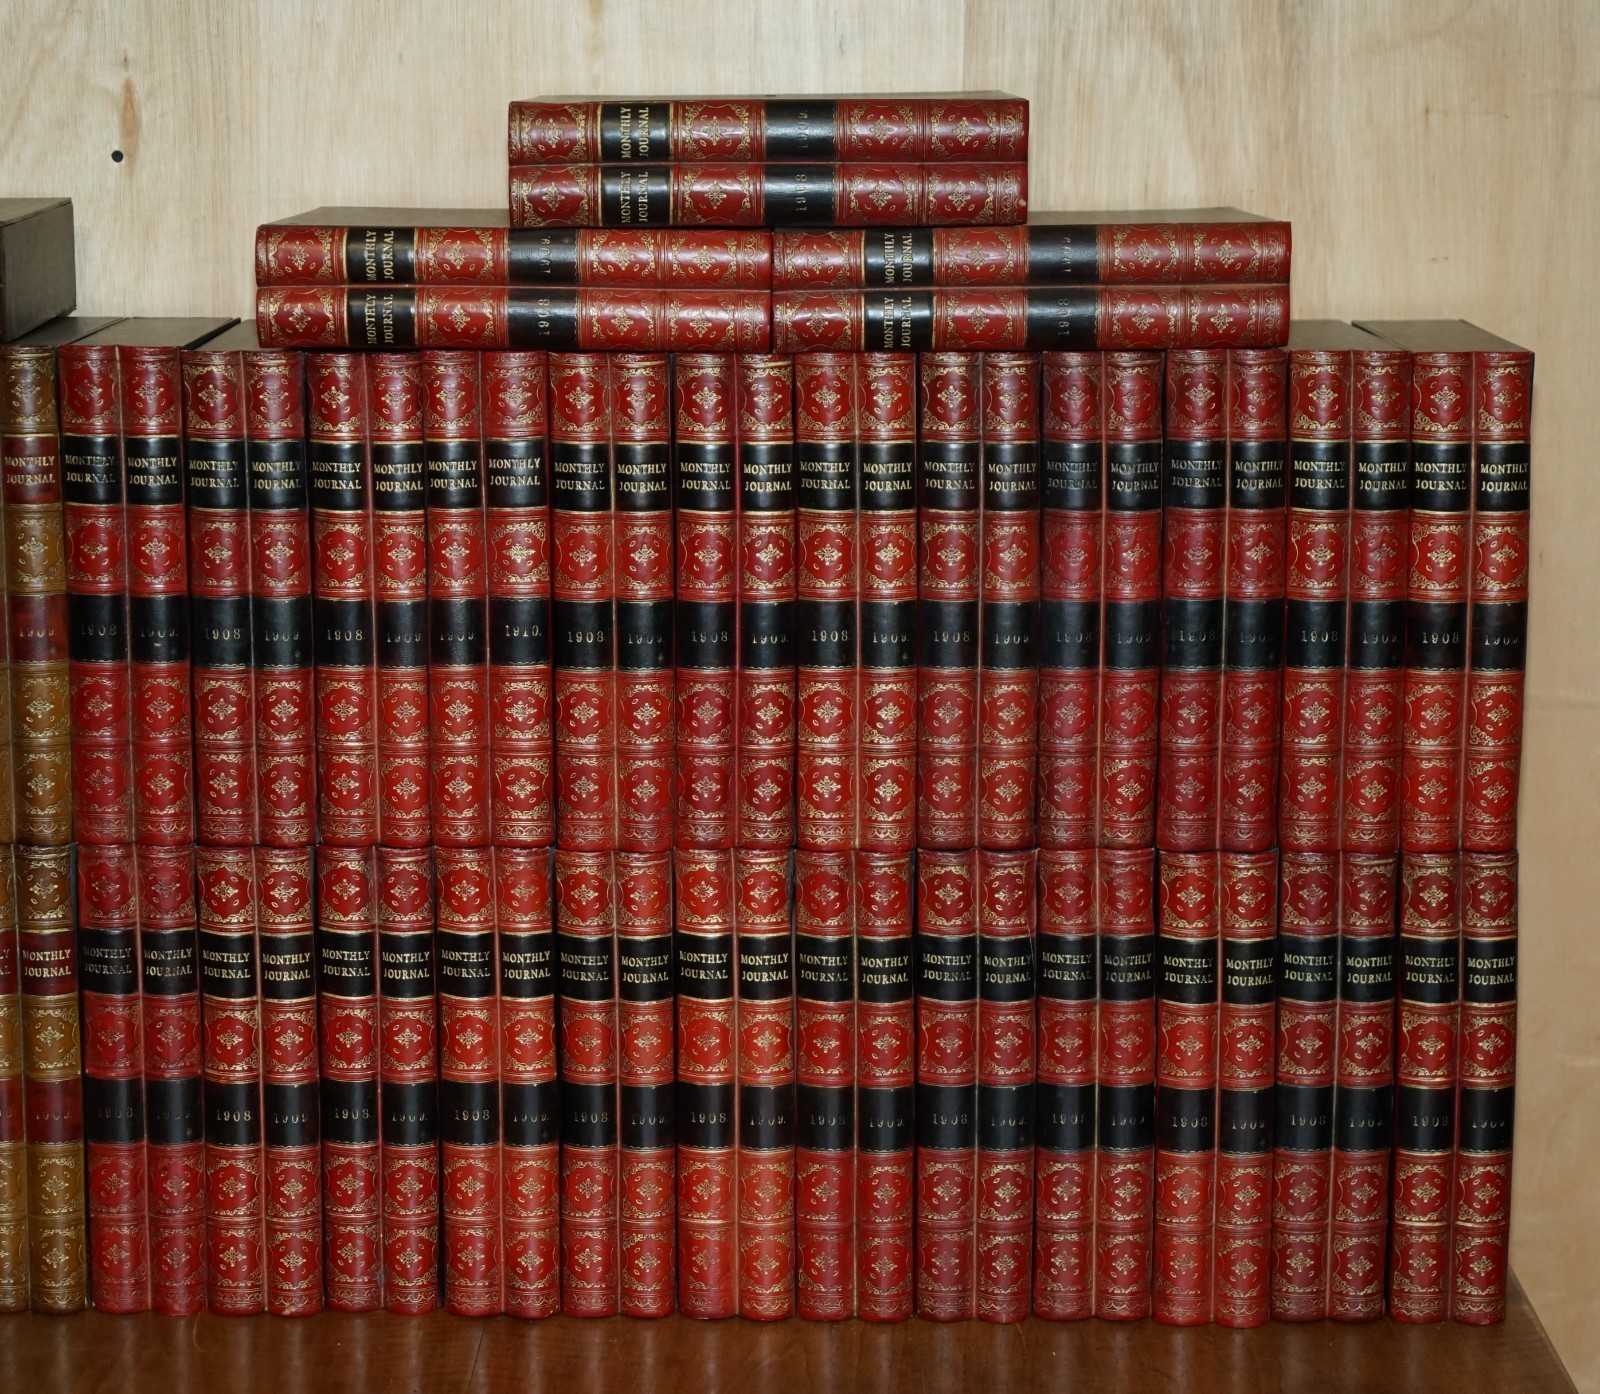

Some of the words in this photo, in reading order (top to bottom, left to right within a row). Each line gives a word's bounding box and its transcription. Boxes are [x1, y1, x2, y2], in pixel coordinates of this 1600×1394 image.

[621, 106, 631, 158] MONTHLY
[639, 107, 649, 157] JOURNAL
[621, 172, 632, 224] MONTHLY
[638, 172, 648, 222] JOURNAL
[366, 230, 376, 280] MONTHLY
[382, 230, 394, 280] JOURNAL
[884, 233, 894, 284] MONTHLY
[902, 232, 912, 282] JOURNAL
[366, 294, 377, 344] MONTHLY
[382, 294, 394, 344] JOURNAL
[884, 297, 894, 348] MONTHLY
[902, 296, 912, 347] JOURNAL
[5, 456, 54, 468] MONTHLY
[128, 456, 177, 468] MONTHLY
[189, 460, 238, 471] MONTHLY
[252, 460, 300, 472] MONTHLY
[312, 461, 361, 472] MONTHLY
[428, 460, 477, 471] MONTHLY
[489, 458, 540, 469] MONTHLY
[680, 462, 730, 474] MONTHLY
[800, 461, 850, 472] MONTHLY
[864, 462, 912, 474] MONTHLY
[924, 461, 974, 472] MONTHLY
[1110, 462, 1159, 474] MONTHLY
[1235, 460, 1283, 472] MONTHLY
[1294, 460, 1344, 472] MONTHLY
[1358, 462, 1407, 473] MONTHLY
[1415, 462, 1466, 472] MONTHLY
[1480, 462, 1528, 474] MONTHLY
[374, 464, 422, 474] MONTHLY
[554, 463, 604, 474] MONTHLY
[618, 463, 666, 475] MONTHLY
[744, 463, 792, 474] MONTHLY
[988, 463, 1037, 474] MONTHLY
[6, 474, 55, 484] JOURNAL
[130, 474, 178, 485] JOURNAL
[191, 478, 240, 488] JOURNAL
[254, 478, 301, 489] JOURNAL
[314, 479, 362, 490] JOURNAL
[430, 478, 478, 488] JOURNAL
[490, 475, 540, 486] JOURNAL
[556, 480, 604, 490] JOURNAL
[682, 478, 731, 490] JOURNAL
[800, 478, 850, 490] JOURNAL
[926, 478, 974, 490] JOURNAL
[1112, 479, 1158, 490] JOURNAL
[1236, 478, 1282, 490] JOURNAL
[1294, 478, 1344, 489] JOURNAL
[1360, 478, 1406, 490] JOURNAL
[1416, 478, 1466, 490] JOURNAL
[376, 480, 423, 492] JOURNAL
[620, 481, 666, 492] JOURNAL
[745, 480, 792, 492] JOURNAL
[865, 480, 912, 491] JOURNAL
[989, 480, 1036, 491] JOURNAL
[1482, 480, 1528, 492] JOURNAL
[22, 949, 71, 961] MONTHLY
[202, 950, 250, 963] MONTHLY
[262, 953, 310, 964] MONTHLY
[322, 948, 370, 961] MONTHLY
[382, 951, 430, 963] MONTHLY
[442, 950, 490, 962] MONTHLY
[502, 951, 550, 963] MONTHLY
[560, 952, 608, 966] MONTHLY
[622, 954, 668, 967] MONTHLY
[680, 950, 728, 964] MONTHLY
[741, 953, 788, 965] MONTHLY
[800, 954, 848, 966] MONTHLY
[922, 954, 972, 965] MONTHLY
[984, 954, 1031, 967] MONTHLY
[1042, 952, 1092, 964] MONTHLY
[1104, 954, 1152, 966] MONTHLY
[1284, 954, 1334, 966] MONTHLY
[1346, 954, 1392, 967] MONTHLY
[1406, 954, 1455, 967] MONTHLY
[861, 956, 908, 968] MONTHLY
[1164, 956, 1213, 968] MONTHLY
[1226, 958, 1274, 970] MONTHLY
[1468, 956, 1515, 968] MONTHLY
[24, 966, 72, 977] JOURNAL
[204, 966, 250, 978] JOURNAL
[264, 970, 310, 981] JOURNAL
[324, 965, 370, 976] JOURNAL
[384, 968, 430, 980] JOURNAL
[443, 966, 490, 978] JOURNAL
[504, 968, 550, 980] JOURNAL
[562, 970, 609, 981] JOURNAL
[622, 971, 668, 982] JOURNAL
[681, 967, 728, 980] JOURNAL
[742, 970, 788, 982] JOURNAL
[801, 970, 848, 982] JOURNAL
[923, 970, 972, 981] JOURNAL
[1043, 968, 1092, 980] JOURNAL
[1106, 970, 1152, 982] JOURNAL
[1284, 970, 1334, 982] JOURNAL
[862, 972, 908, 984] JOURNAL
[986, 972, 1031, 983] JOURNAL
[1165, 972, 1214, 984] JOURNAL
[1227, 974, 1274, 986] JOURNAL
[1348, 972, 1392, 984] JOURNAL
[1406, 972, 1454, 984] JOURNAL
[1469, 973, 1514, 986] JOURNAL
